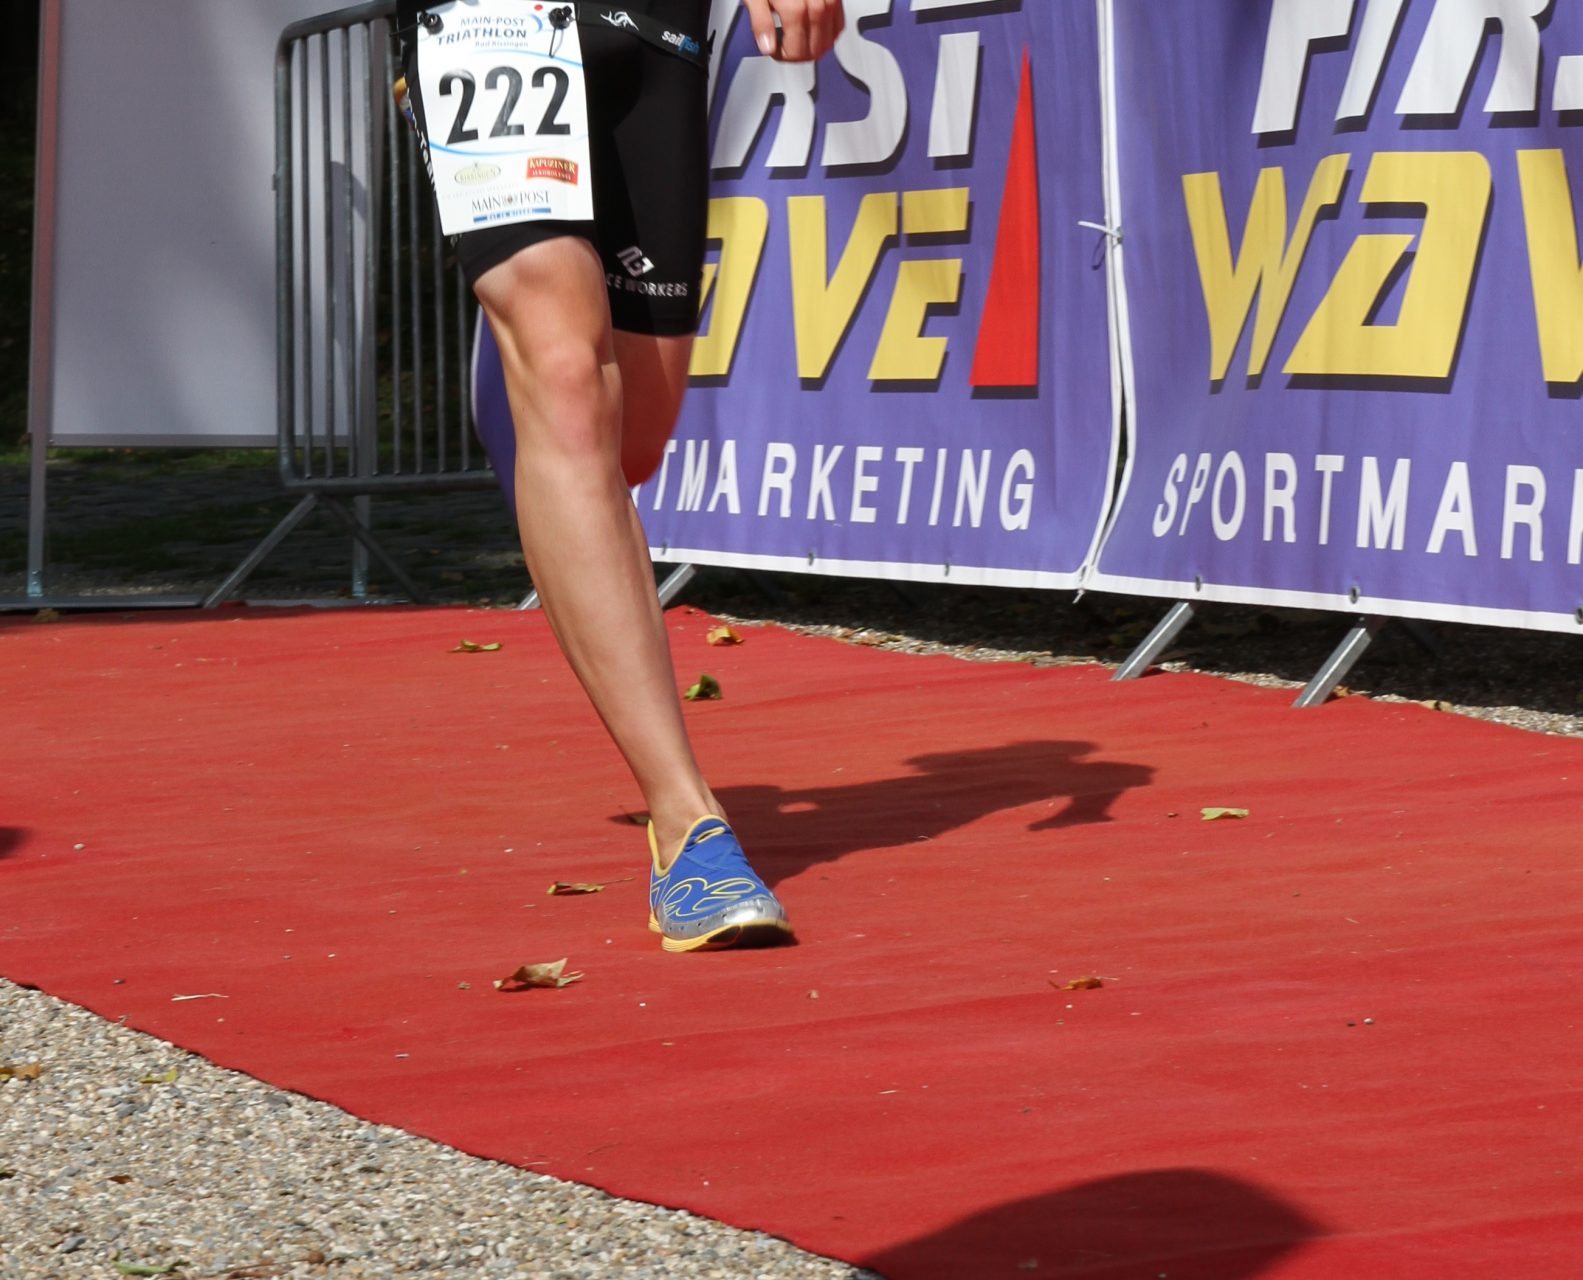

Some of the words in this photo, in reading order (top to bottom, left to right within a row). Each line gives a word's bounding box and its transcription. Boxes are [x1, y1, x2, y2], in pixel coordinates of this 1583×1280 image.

[460, 15, 527, 27] MAIN-POST
[437, 27, 528, 46] TRIATHLON
[438, 65, 571, 146] 222
[528, 158, 576, 176] KAPUZINER
[471, 195, 501, 212] MAIN
[519, 190, 550, 204] POST
